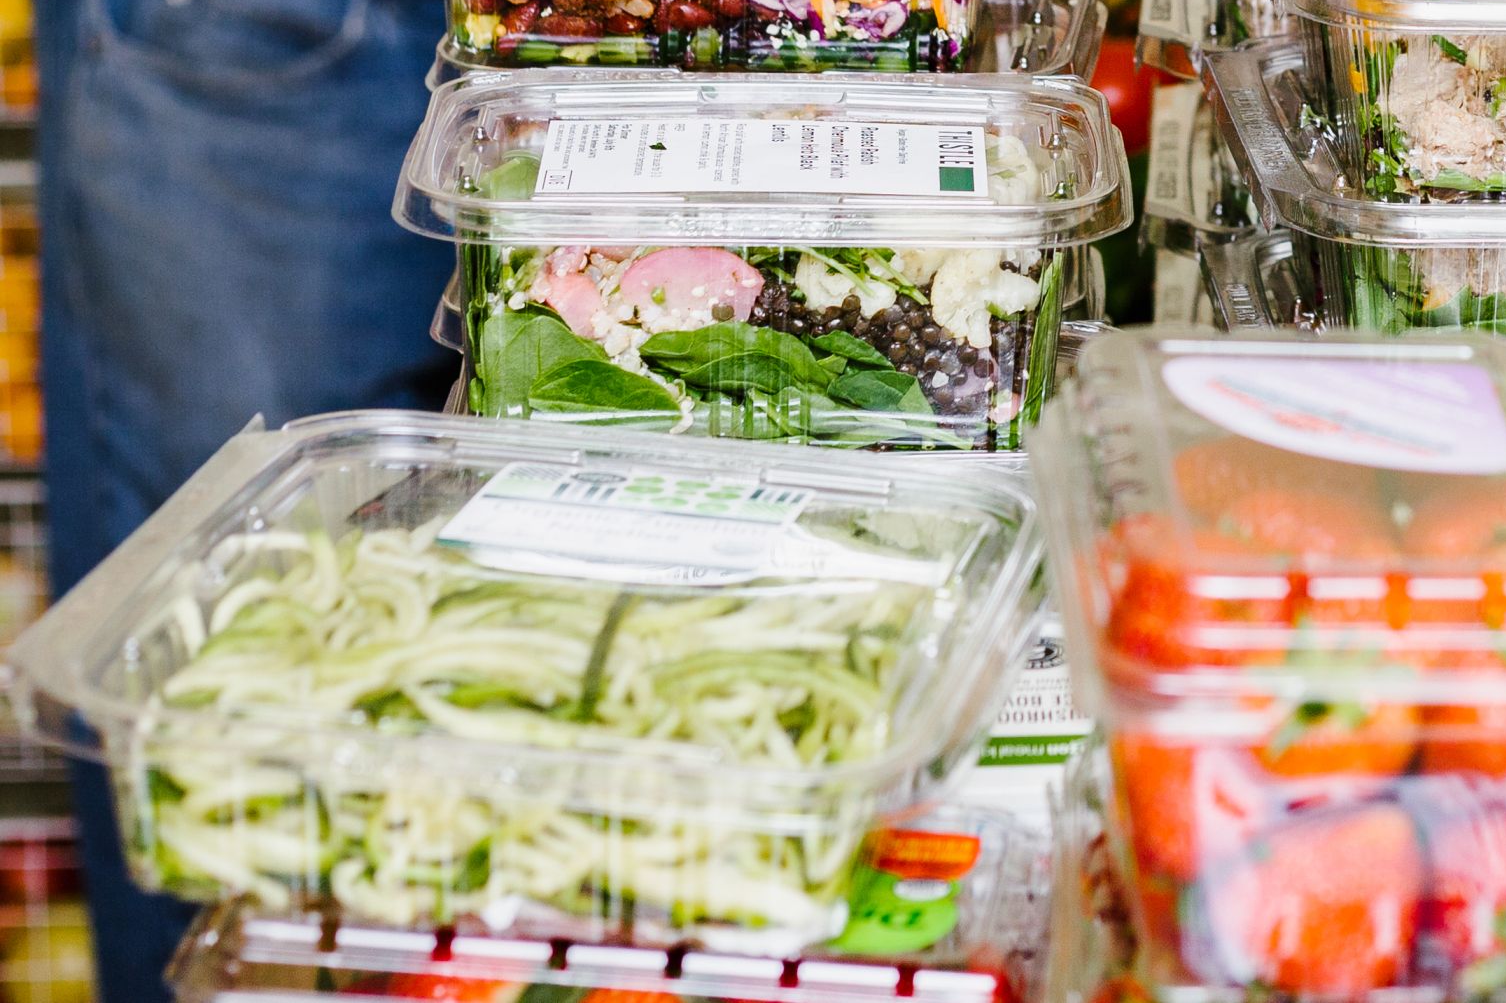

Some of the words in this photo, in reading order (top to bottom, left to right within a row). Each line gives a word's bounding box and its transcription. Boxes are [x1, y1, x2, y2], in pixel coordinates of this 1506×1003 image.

[801, 125, 820, 144] Lemon
[860, 126, 879, 147] Roasted
[938, 129, 975, 165] THISTLE
[800, 155, 819, 171] Black
